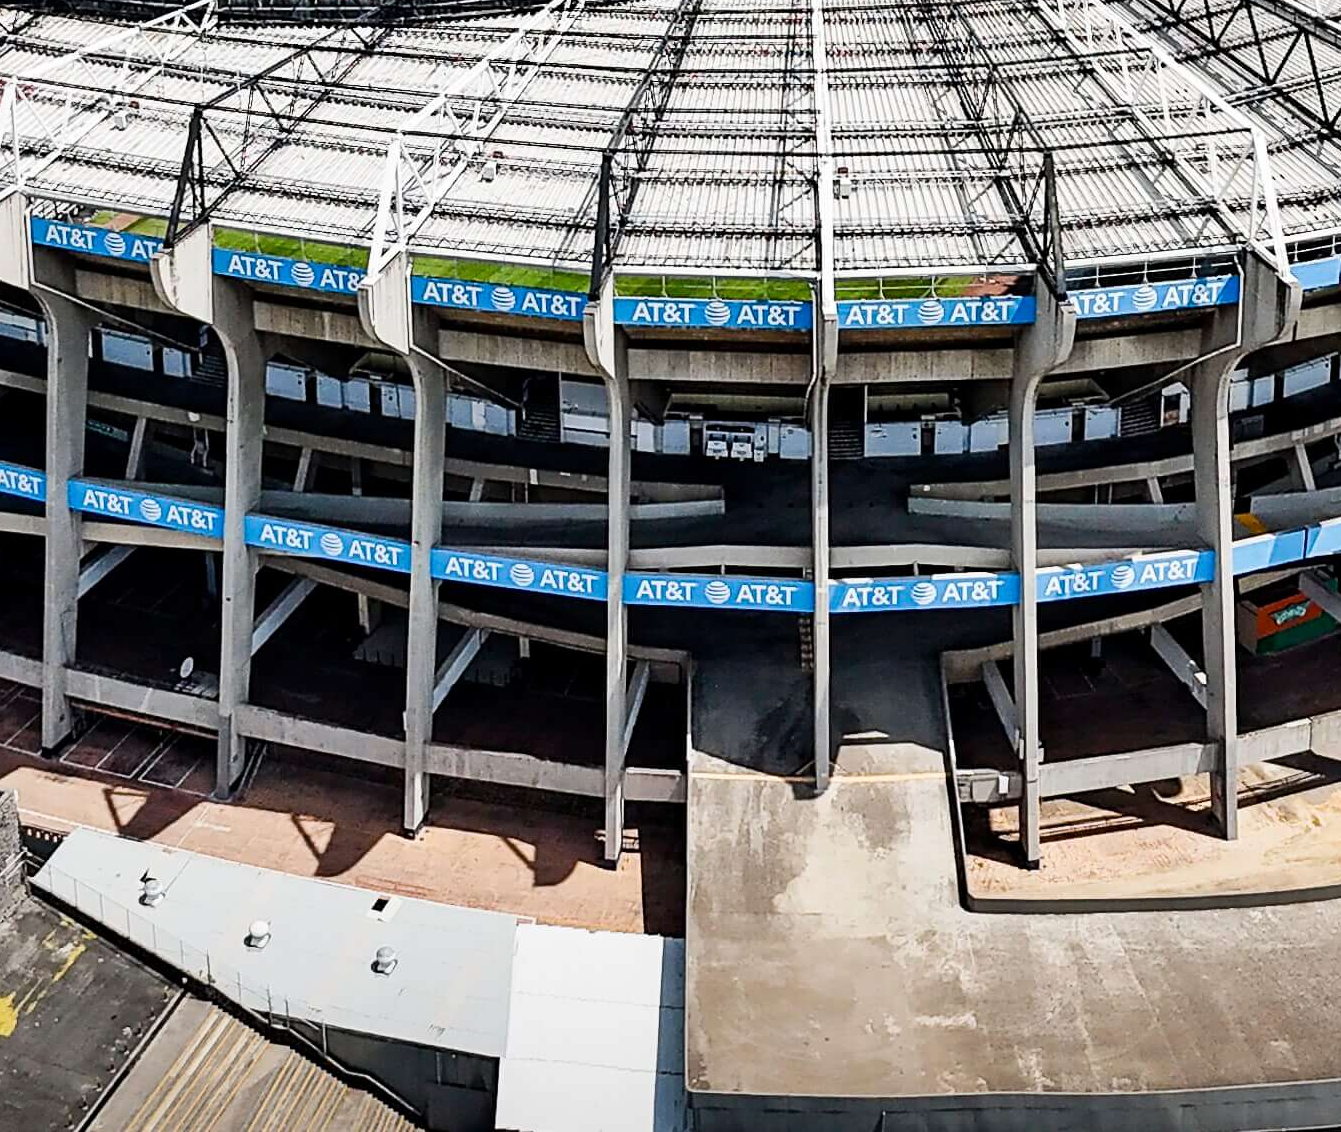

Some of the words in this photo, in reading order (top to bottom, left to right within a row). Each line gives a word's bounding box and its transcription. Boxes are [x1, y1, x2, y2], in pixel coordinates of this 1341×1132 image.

[47, 226, 96, 249] AT&T
[229, 256, 282, 280] AT&T
[424, 282, 482, 309] AT&T
[523, 293, 581, 317] AT&T
[845, 304, 910, 325] AT&T
[950, 301, 1015, 323] AT&T
[1069, 291, 1126, 316] AT&T
[1161, 282, 1224, 308] AT&T
[633, 304, 695, 324] AT&T
[738, 306, 800, 325] AT&T
[84, 490, 132, 514] AT&T
[168, 506, 216, 530] AT&T
[261, 525, 314, 549] AT&T
[350, 541, 402, 565] AT&T
[446, 558, 503, 581] AT&T
[541, 570, 598, 593] AT&T
[1044, 570, 1105, 597] AT&T
[1140, 557, 1198, 584] AT&T
[637, 580, 697, 601] AT&T
[737, 585, 797, 606] AT&T
[842, 586, 904, 607] AT&T
[942, 580, 1002, 602] AT&T
